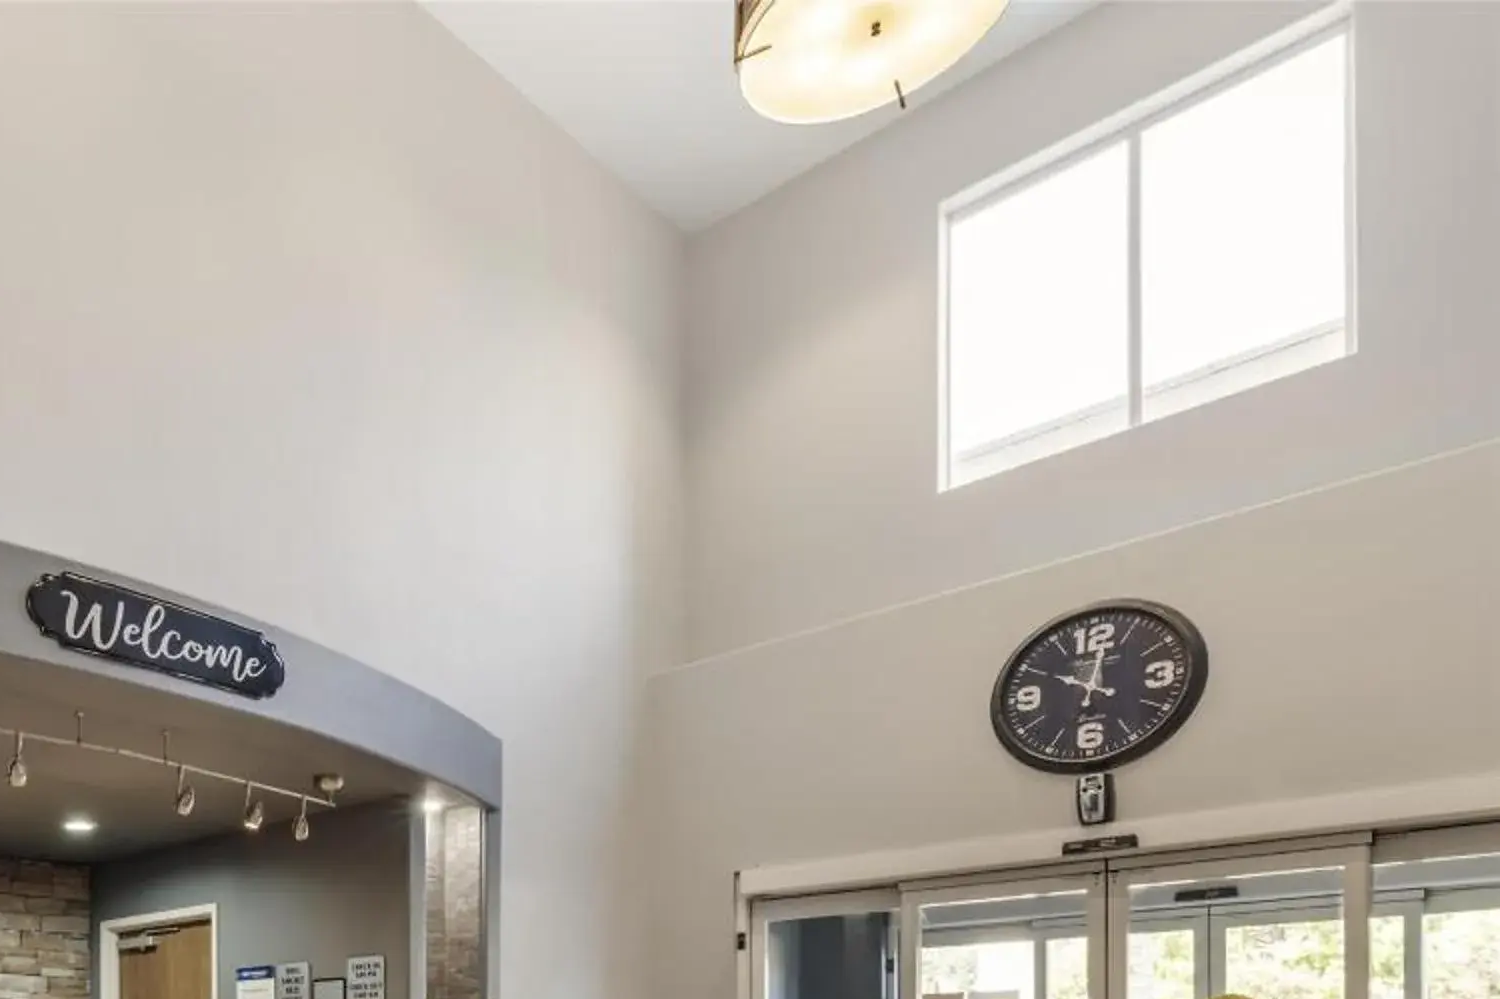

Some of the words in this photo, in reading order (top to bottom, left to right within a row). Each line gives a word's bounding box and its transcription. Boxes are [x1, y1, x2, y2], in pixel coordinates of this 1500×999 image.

[60, 589, 267, 682] Welcome
[1073, 623, 1115, 655] 12
[1144, 659, 1175, 689] 3
[1015, 684, 1041, 711] 9
[1076, 722, 1104, 749] 6
